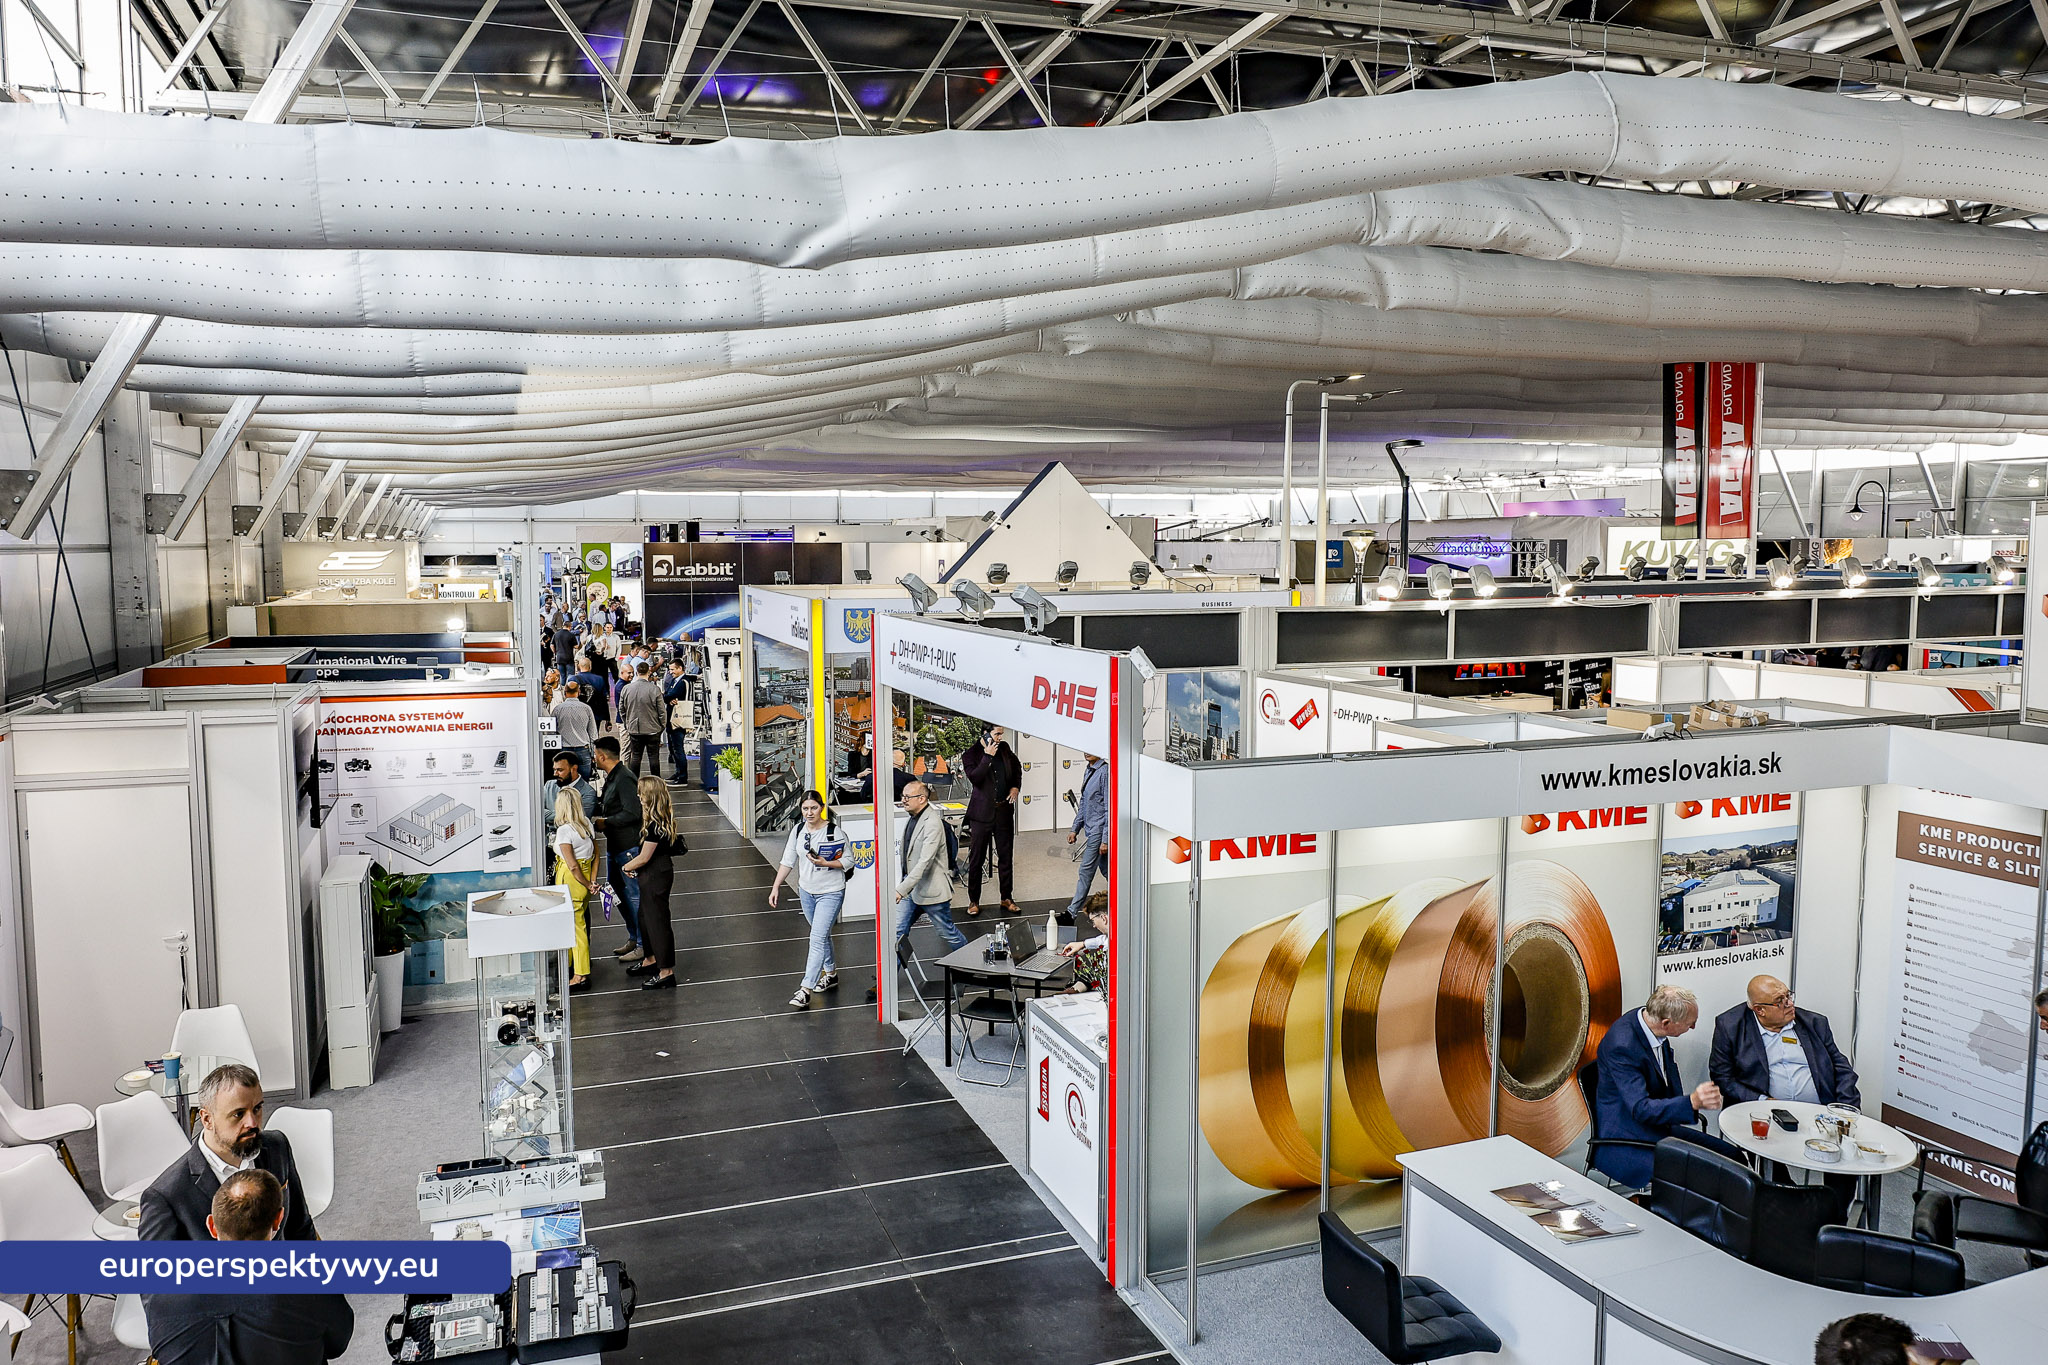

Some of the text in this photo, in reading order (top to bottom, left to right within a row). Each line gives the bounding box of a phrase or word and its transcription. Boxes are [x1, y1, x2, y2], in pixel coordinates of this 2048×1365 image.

[676, 563, 734, 576] rabbit
[372, 577, 396, 586] KOLEI
[378, 655, 408, 665] Wire
[899, 640, 956, 672] DH-PWP-1-PLUS
[316, 668, 340, 678] ope
[398, 710, 464, 722] SYSTEMÓW
[336, 722, 494, 736] MAGAZYNOWANIA ENERGII
[540, 722, 551, 730] 61
[544, 740, 557, 748] 60
[1541, 752, 1782, 790] www.kmeslovakia.sk
[1711, 793, 1792, 818] KME
[1558, 805, 1648, 832] KME
[1920, 824, 1952, 842] KME
[1210, 833, 1316, 862] KME
[1918, 842, 1982, 866] SERVICE
[1988, 856, 2000, 870] &
[1663, 945, 1785, 974] www.kmeslovakia.sk
[1913, 1141, 2015, 1194] .KME.COM
